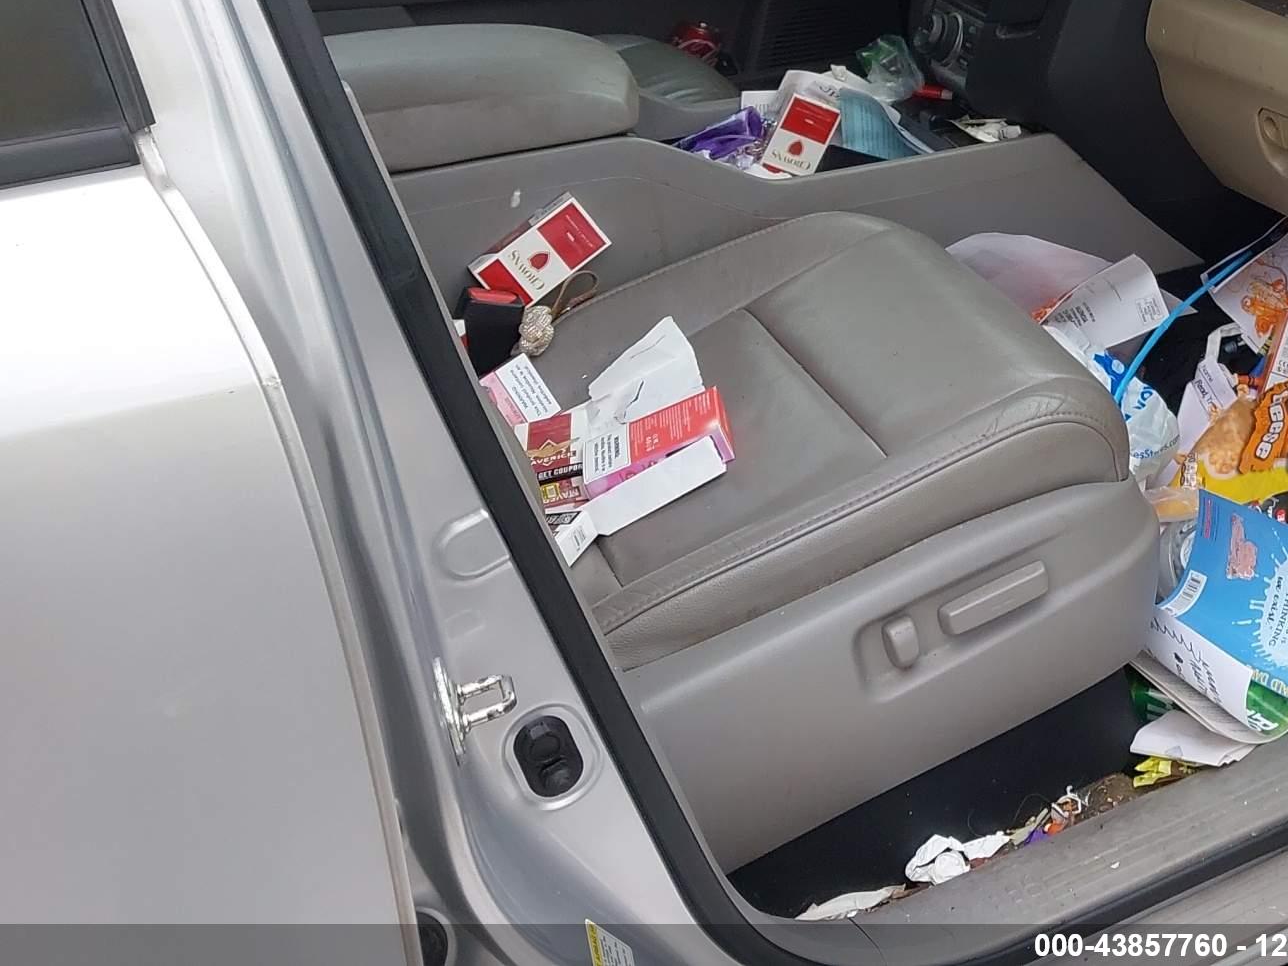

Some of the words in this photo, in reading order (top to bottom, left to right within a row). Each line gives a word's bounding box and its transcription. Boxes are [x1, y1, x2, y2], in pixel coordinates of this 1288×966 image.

[771, 149, 811, 170] CROWNS
[508, 249, 545, 291] CROWNS
[538, 470, 552, 480] GET
